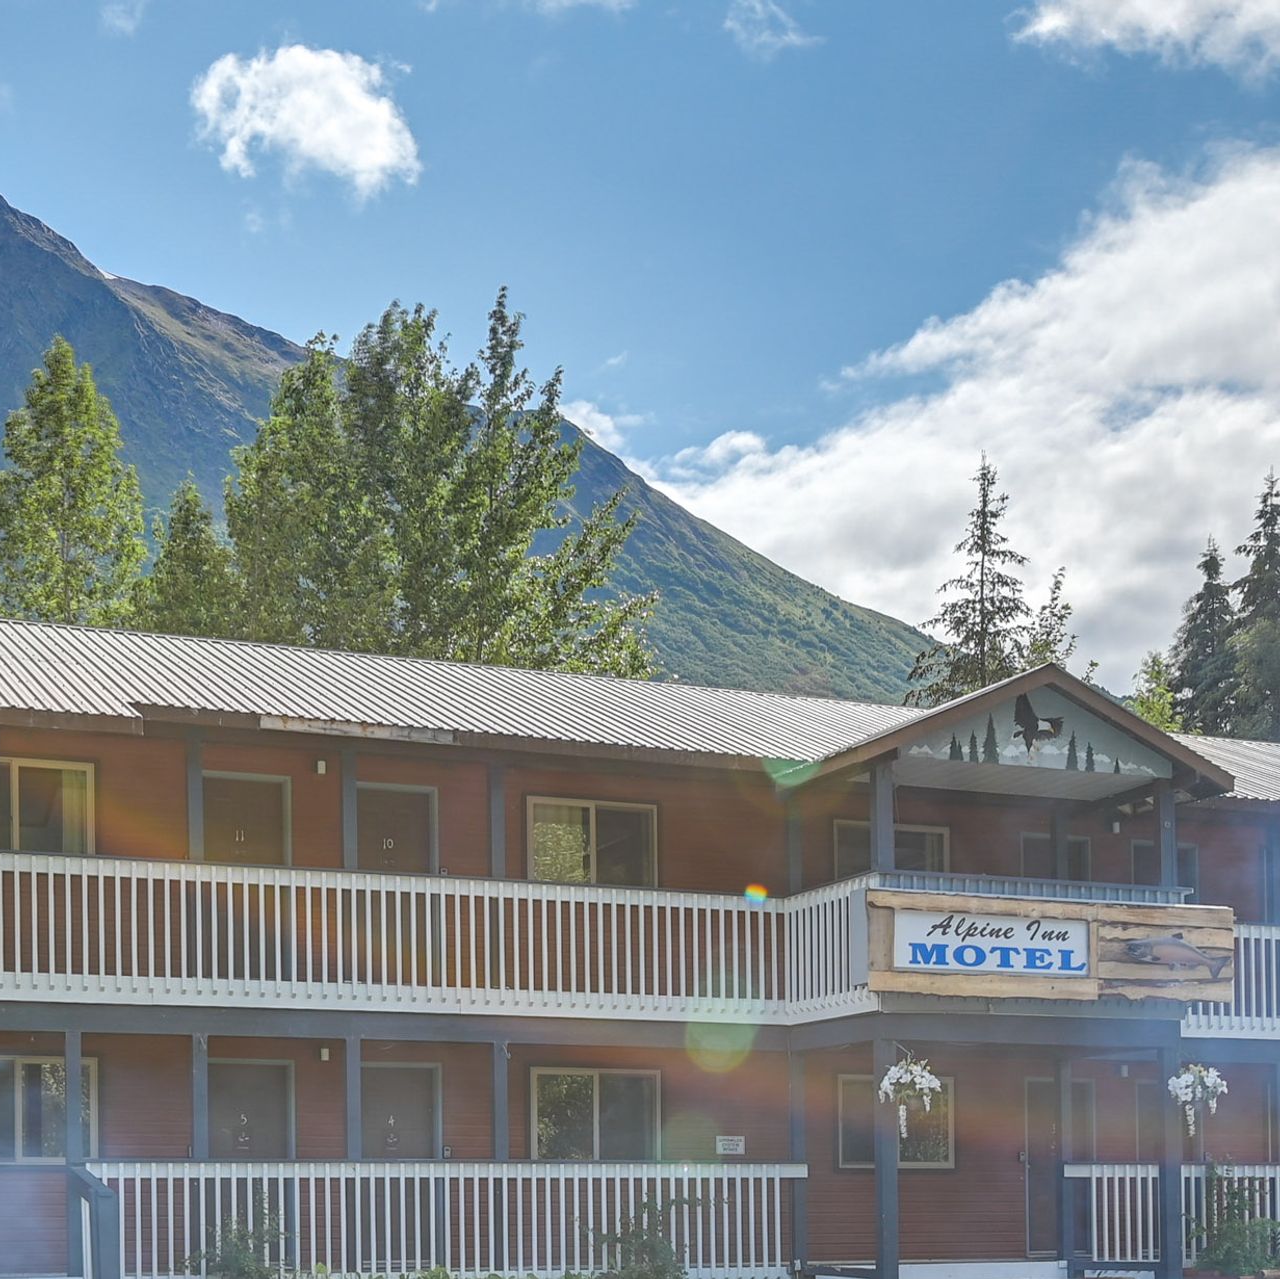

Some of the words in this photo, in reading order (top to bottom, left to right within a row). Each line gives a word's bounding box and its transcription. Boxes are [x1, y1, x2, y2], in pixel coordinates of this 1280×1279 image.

[383, 838, 394, 849] 10
[926, 914, 1015, 943] Alpine
[1025, 919, 1071, 942] Inn
[908, 942, 1087, 972] MOTEL
[240, 1113, 248, 1125] 5
